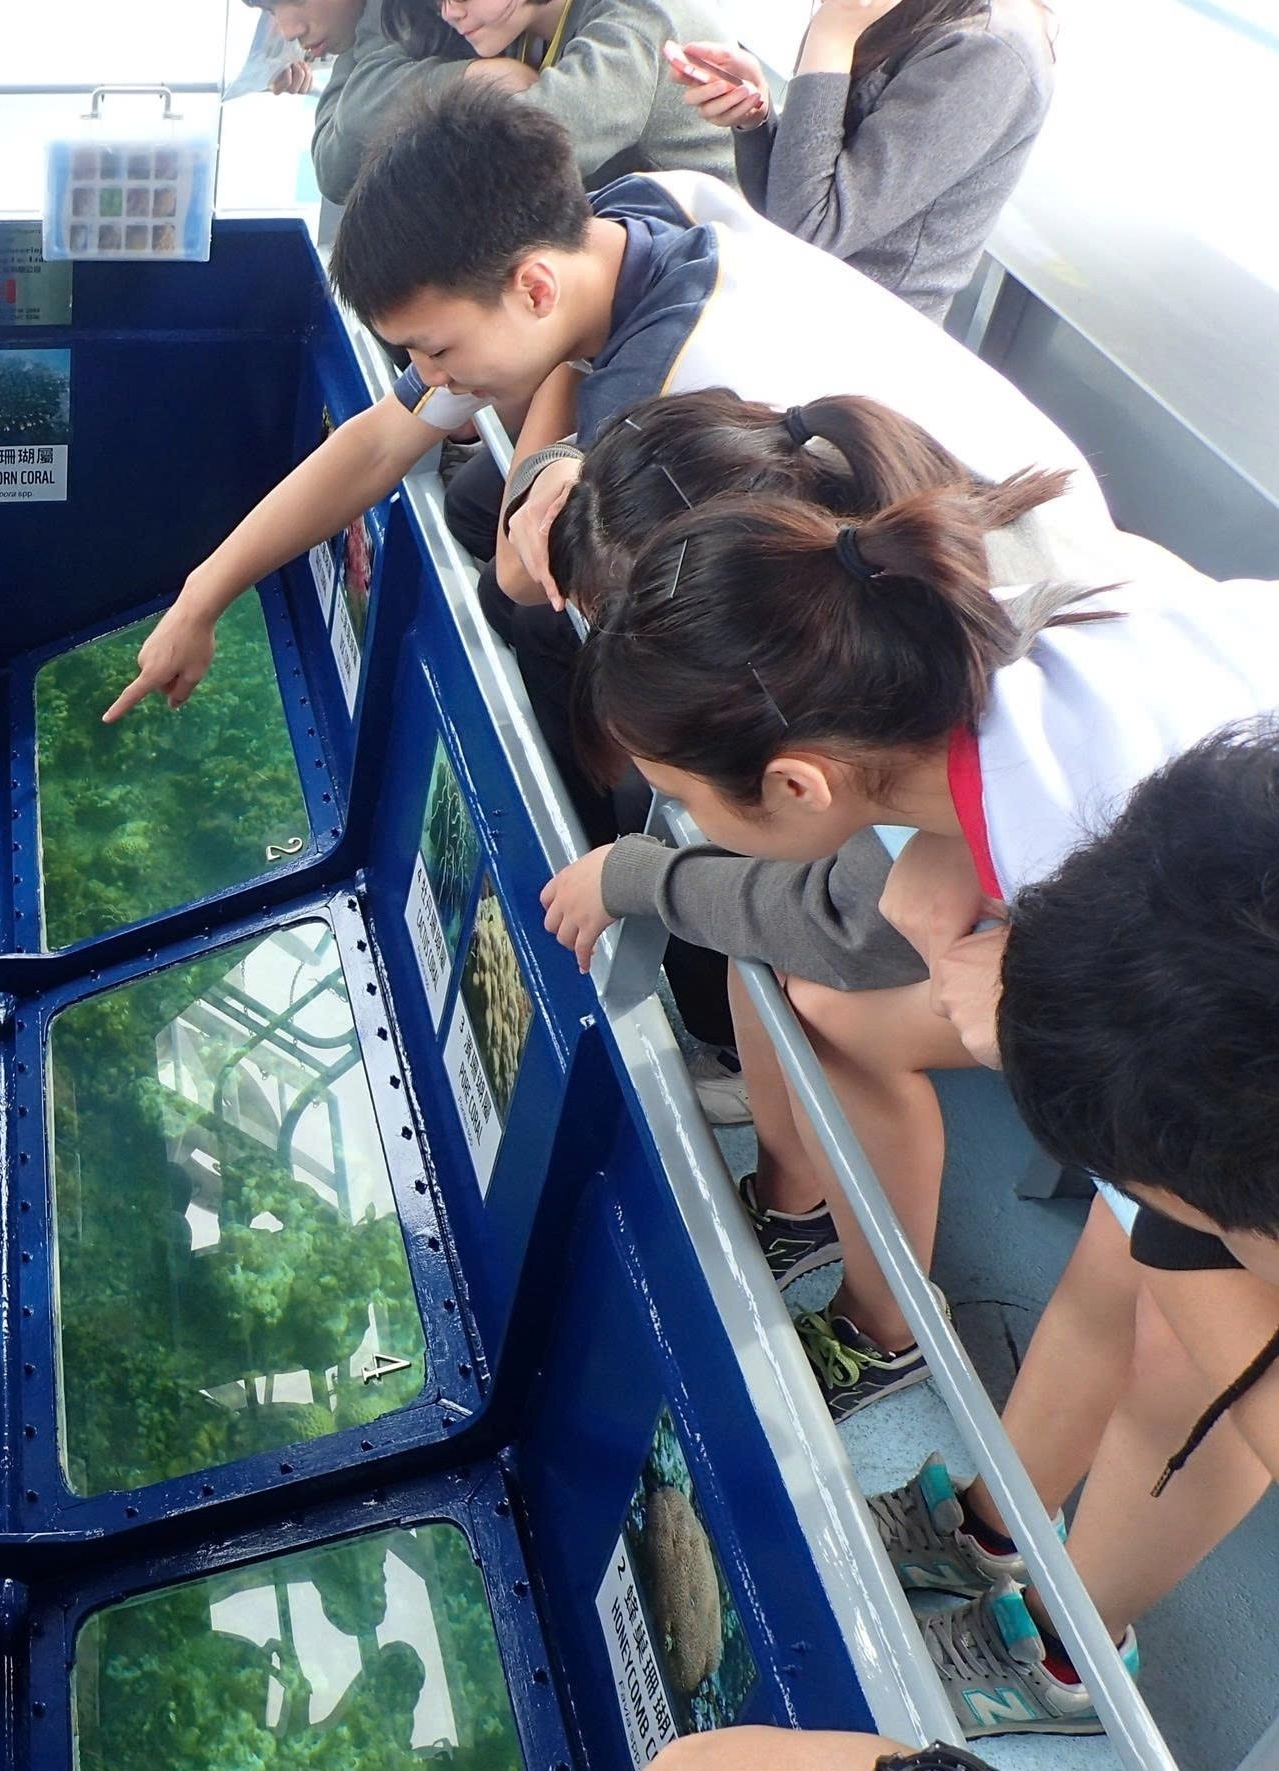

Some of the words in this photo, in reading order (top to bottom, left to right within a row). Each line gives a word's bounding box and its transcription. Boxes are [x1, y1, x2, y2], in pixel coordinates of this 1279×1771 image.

[21, 470, 55, 485] CORAL
[265, 836, 303, 861] 2
[427, 948, 439, 992] CORAL
[459, 1012, 465, 1037] 3
[467, 1095, 483, 1146] CORAL
[362, 1353, 412, 1384] 4
[611, 1596, 649, 1739] HONEYCOMB
[617, 1555, 626, 1581] 2
[624, 1585, 676, 1744] 蜂巢珊瑚
[962, 1686, 1038, 1728] N
